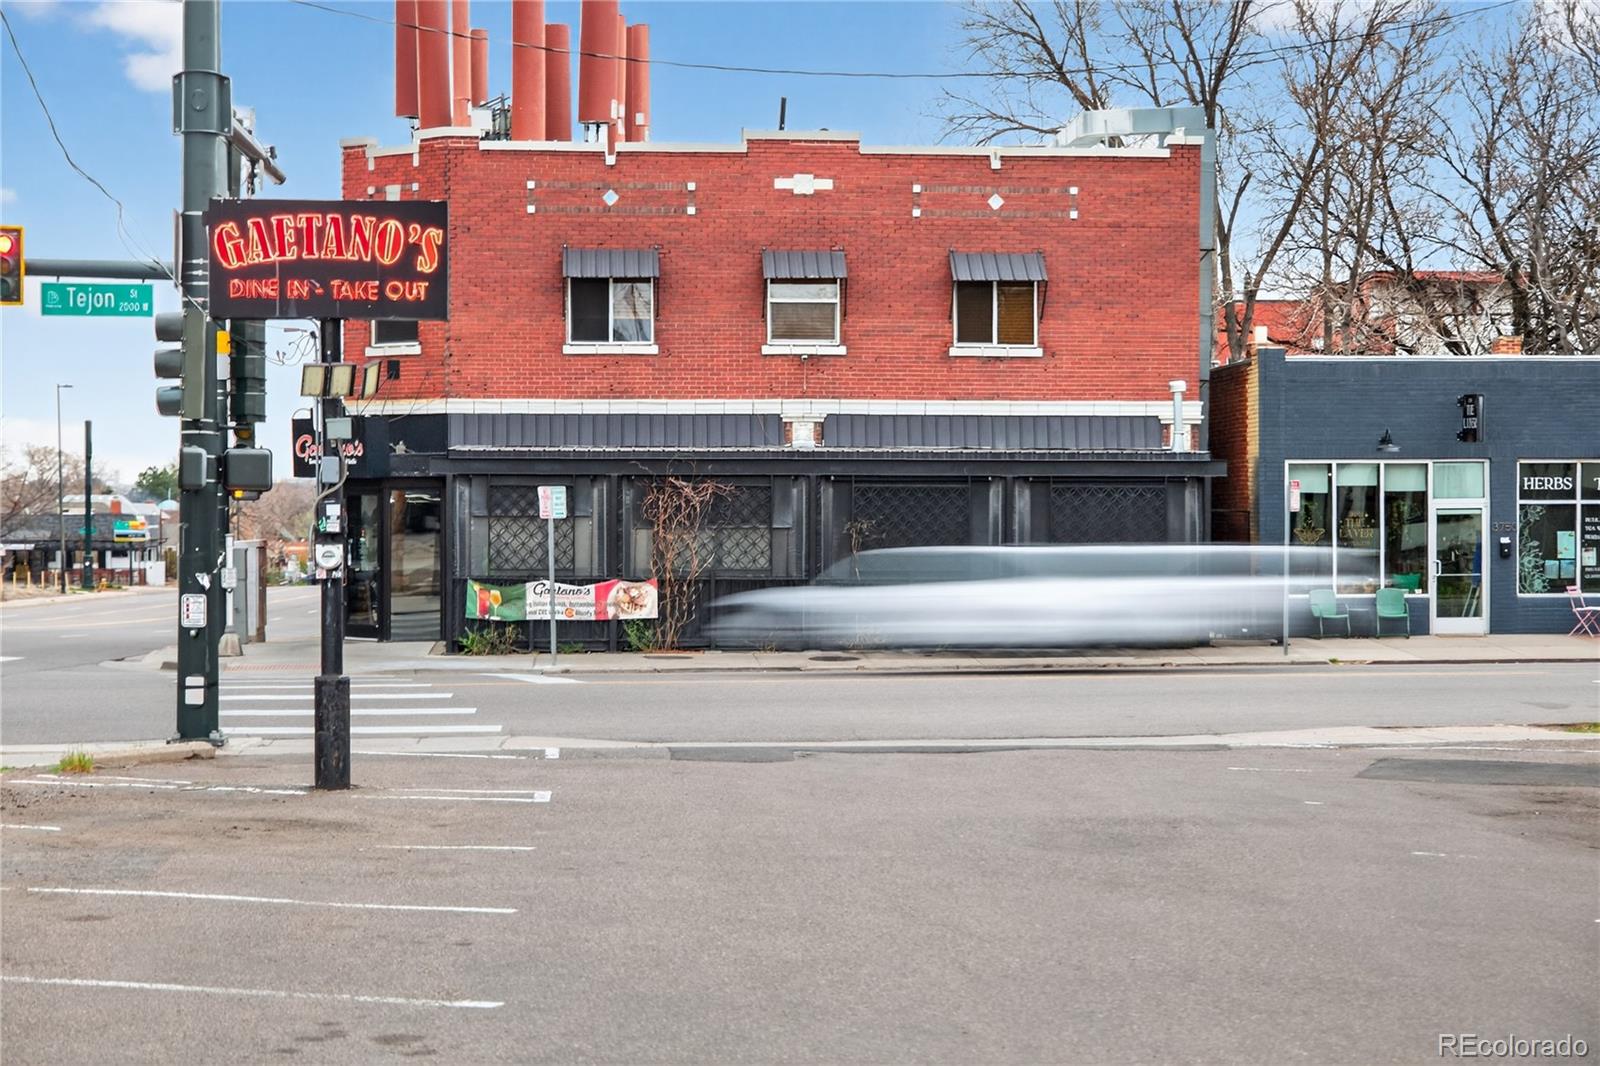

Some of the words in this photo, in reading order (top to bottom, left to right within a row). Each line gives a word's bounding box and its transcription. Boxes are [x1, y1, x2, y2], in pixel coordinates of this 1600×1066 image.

[213, 212, 443, 273] GAETANO'S
[66, 286, 115, 315] Tejon
[229, 278, 279, 299] DINE
[287, 279, 310, 300] IN
[330, 279, 380, 301] TAKE
[385, 280, 429, 302] OUT
[119, 302, 140, 312] 2000
[1522, 476, 1573, 491] HERBS
